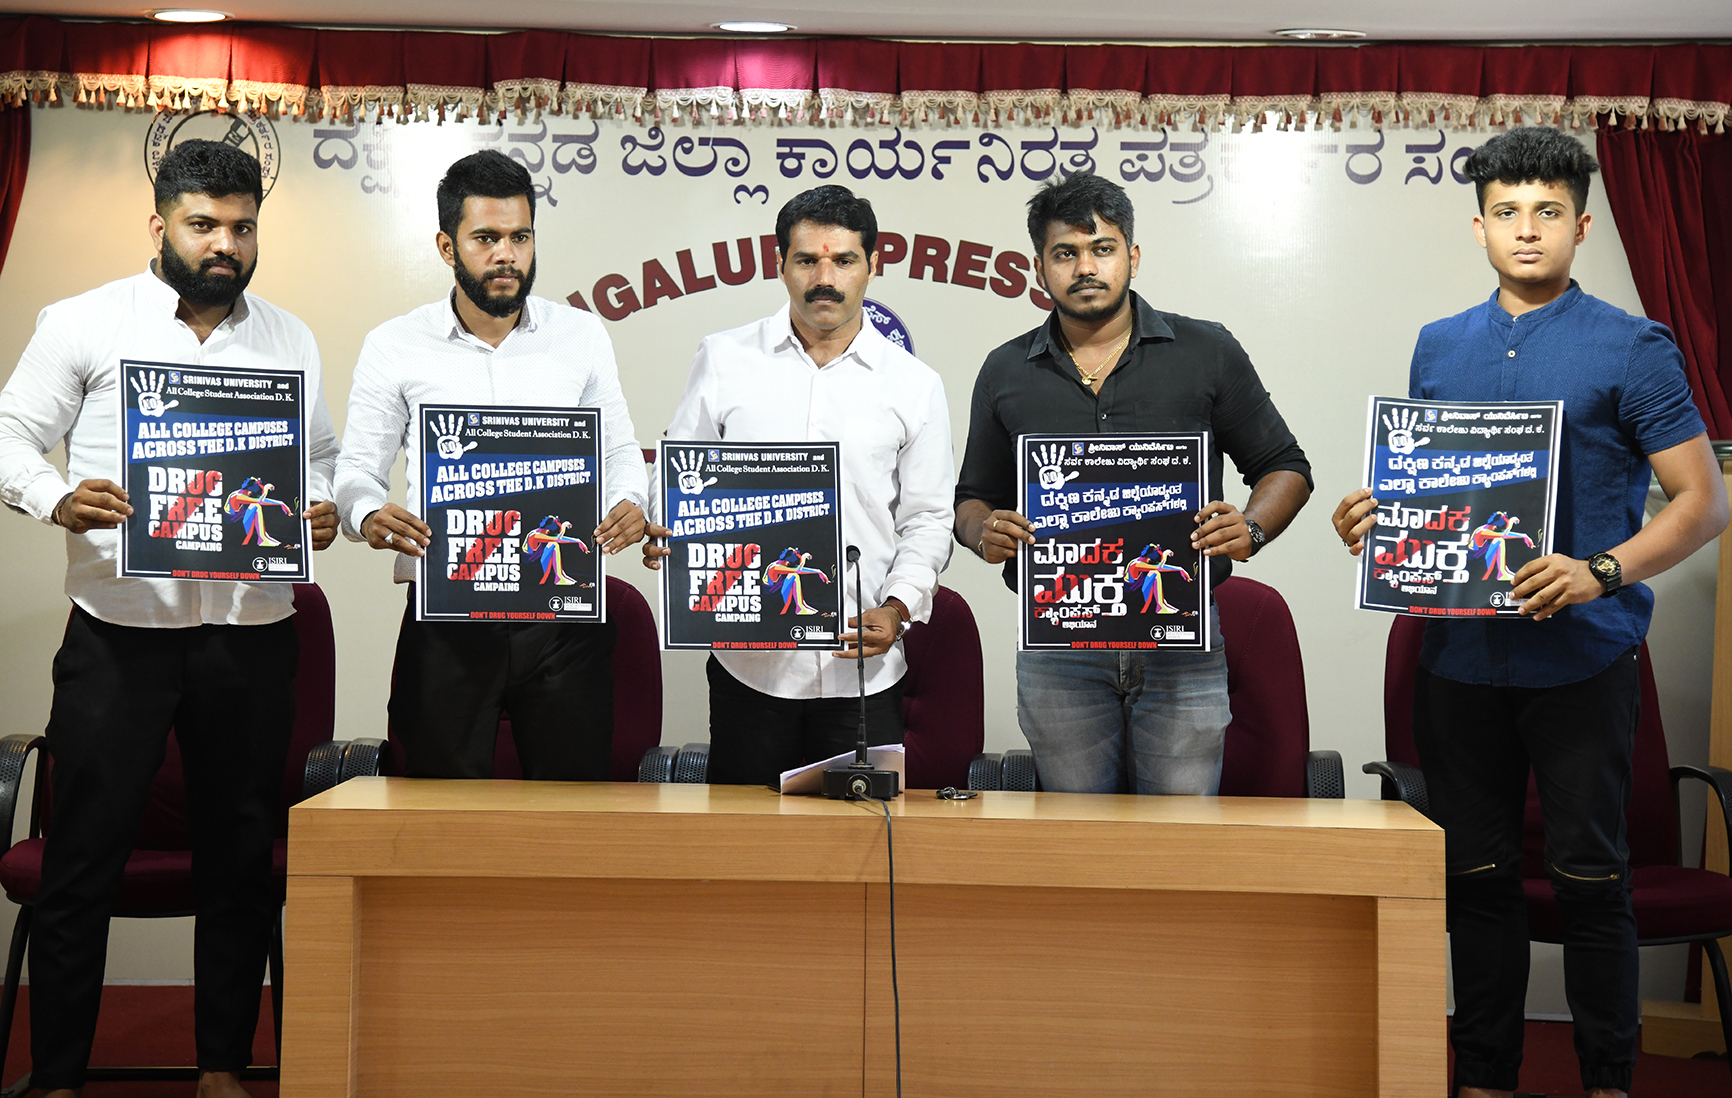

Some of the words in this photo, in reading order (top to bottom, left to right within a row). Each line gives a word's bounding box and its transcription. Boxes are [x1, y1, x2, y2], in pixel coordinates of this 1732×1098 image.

[620, 126, 769, 205] ಜಿಲ್ಲಾ
[183, 375, 222, 386] SRINIVAS
[223, 378, 272, 389] UNIVERSITY
[166, 386, 177, 395] All
[177, 387, 204, 398] College
[204, 389, 233, 398] Student
[234, 391, 274, 400] Association
[138, 422, 171, 439] ALL
[172, 422, 233, 438] COLLEGE
[234, 421, 288, 436] CAMPUSES
[482, 416, 520, 426] SRINIVAS
[522, 417, 570, 427] UNIVERSITY
[465, 428, 476, 436] All
[477, 429, 503, 439] College
[503, 429, 531, 437] Student
[532, 430, 571, 438] Association
[132, 440, 196, 459] ACROSS
[197, 438, 225, 454] THE
[226, 437, 246, 452] D.K
[248, 433, 294, 450] DISTRICT
[722, 452, 759, 461] SRINIVAS
[761, 452, 808, 461] UNIVERSITY
[436, 465, 469, 483] ALL
[471, 461, 531, 480] COLLEGE
[533, 458, 585, 474] CAMPUSES
[705, 464, 716, 472] All
[717, 464, 742, 474] College
[743, 465, 770, 473] Student
[148, 466, 223, 497] DRUG
[431, 480, 495, 503] ACROSS
[496, 478, 523, 494] THE
[524, 475, 544, 491] D.K
[547, 471, 591, 488] DISTRICT
[149, 494, 222, 524] FREE
[678, 500, 710, 517] ALL
[711, 496, 771, 514] COLLEGE
[772, 491, 824, 508] CAMPUSES
[446, 509, 521, 536] DRUG
[672, 515, 734, 537] ACROSS
[736, 512, 762, 528] THE
[763, 509, 784, 524] D.K
[786, 503, 830, 521] DISTRICT
[148, 520, 223, 541] CAMPUS
[176, 540, 222, 552] CAMPAING
[448, 537, 520, 564] FREE
[687, 543, 761, 569] DRUG
[447, 563, 521, 581] CAMPUS
[474, 582, 519, 592] CAMPAING
[689, 570, 760, 595] FREE
[689, 595, 761, 612] CAMPUS
[1428, 607, 1446, 615] DRUG
[1445, 608, 1476, 616] YOURSELF
[1477, 608, 1498, 616] DOWN
[715, 613, 761, 622] CAMPAING
